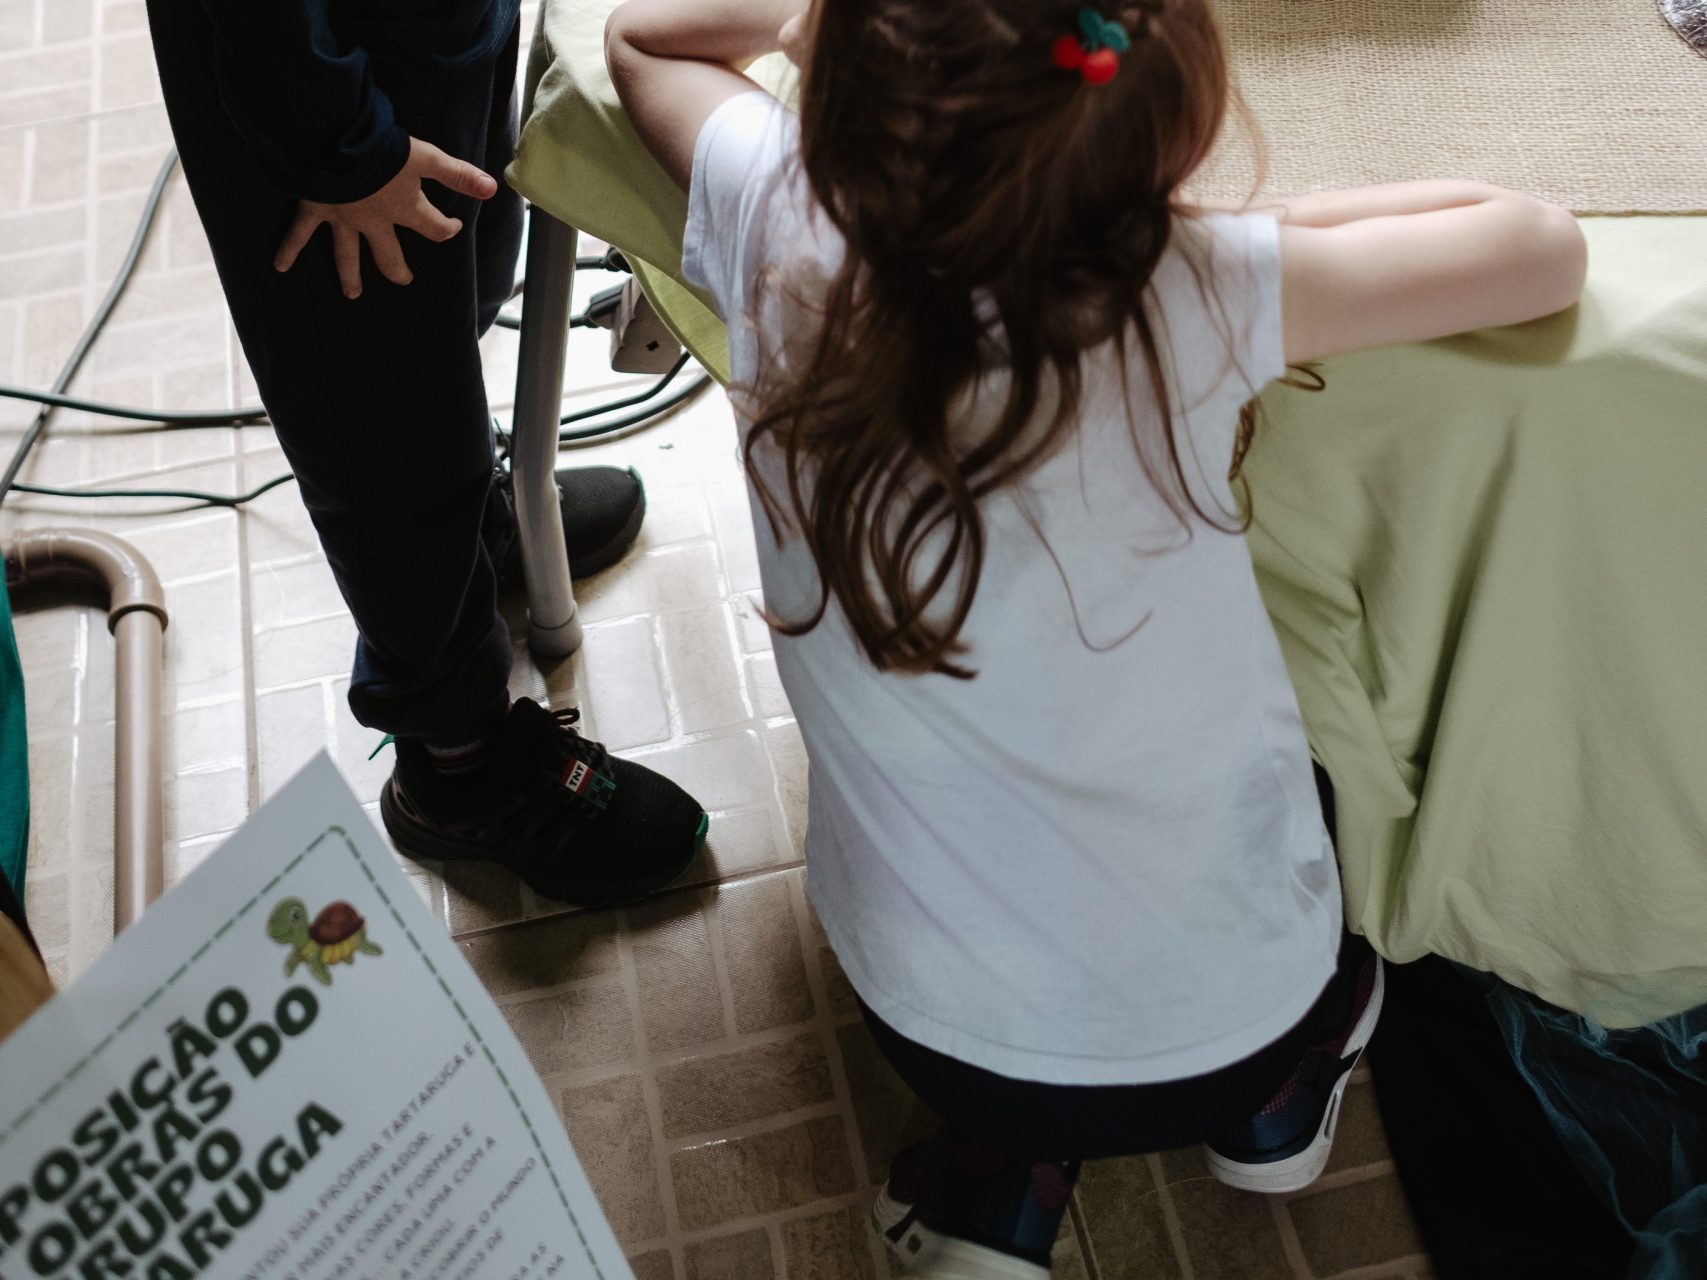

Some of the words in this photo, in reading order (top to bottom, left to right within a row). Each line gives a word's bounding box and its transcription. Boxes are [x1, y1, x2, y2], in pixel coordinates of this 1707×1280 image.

[569, 766, 584, 786] TNT
[0, 987, 248, 1245] POSIÇÃO
[29, 1067, 233, 1276] OBRAS
[234, 985, 319, 1079] DO
[382, 1054, 464, 1141] TARTARUGA
[79, 1127, 242, 1280] RUPO
[149, 1100, 344, 1280] ARUGA
